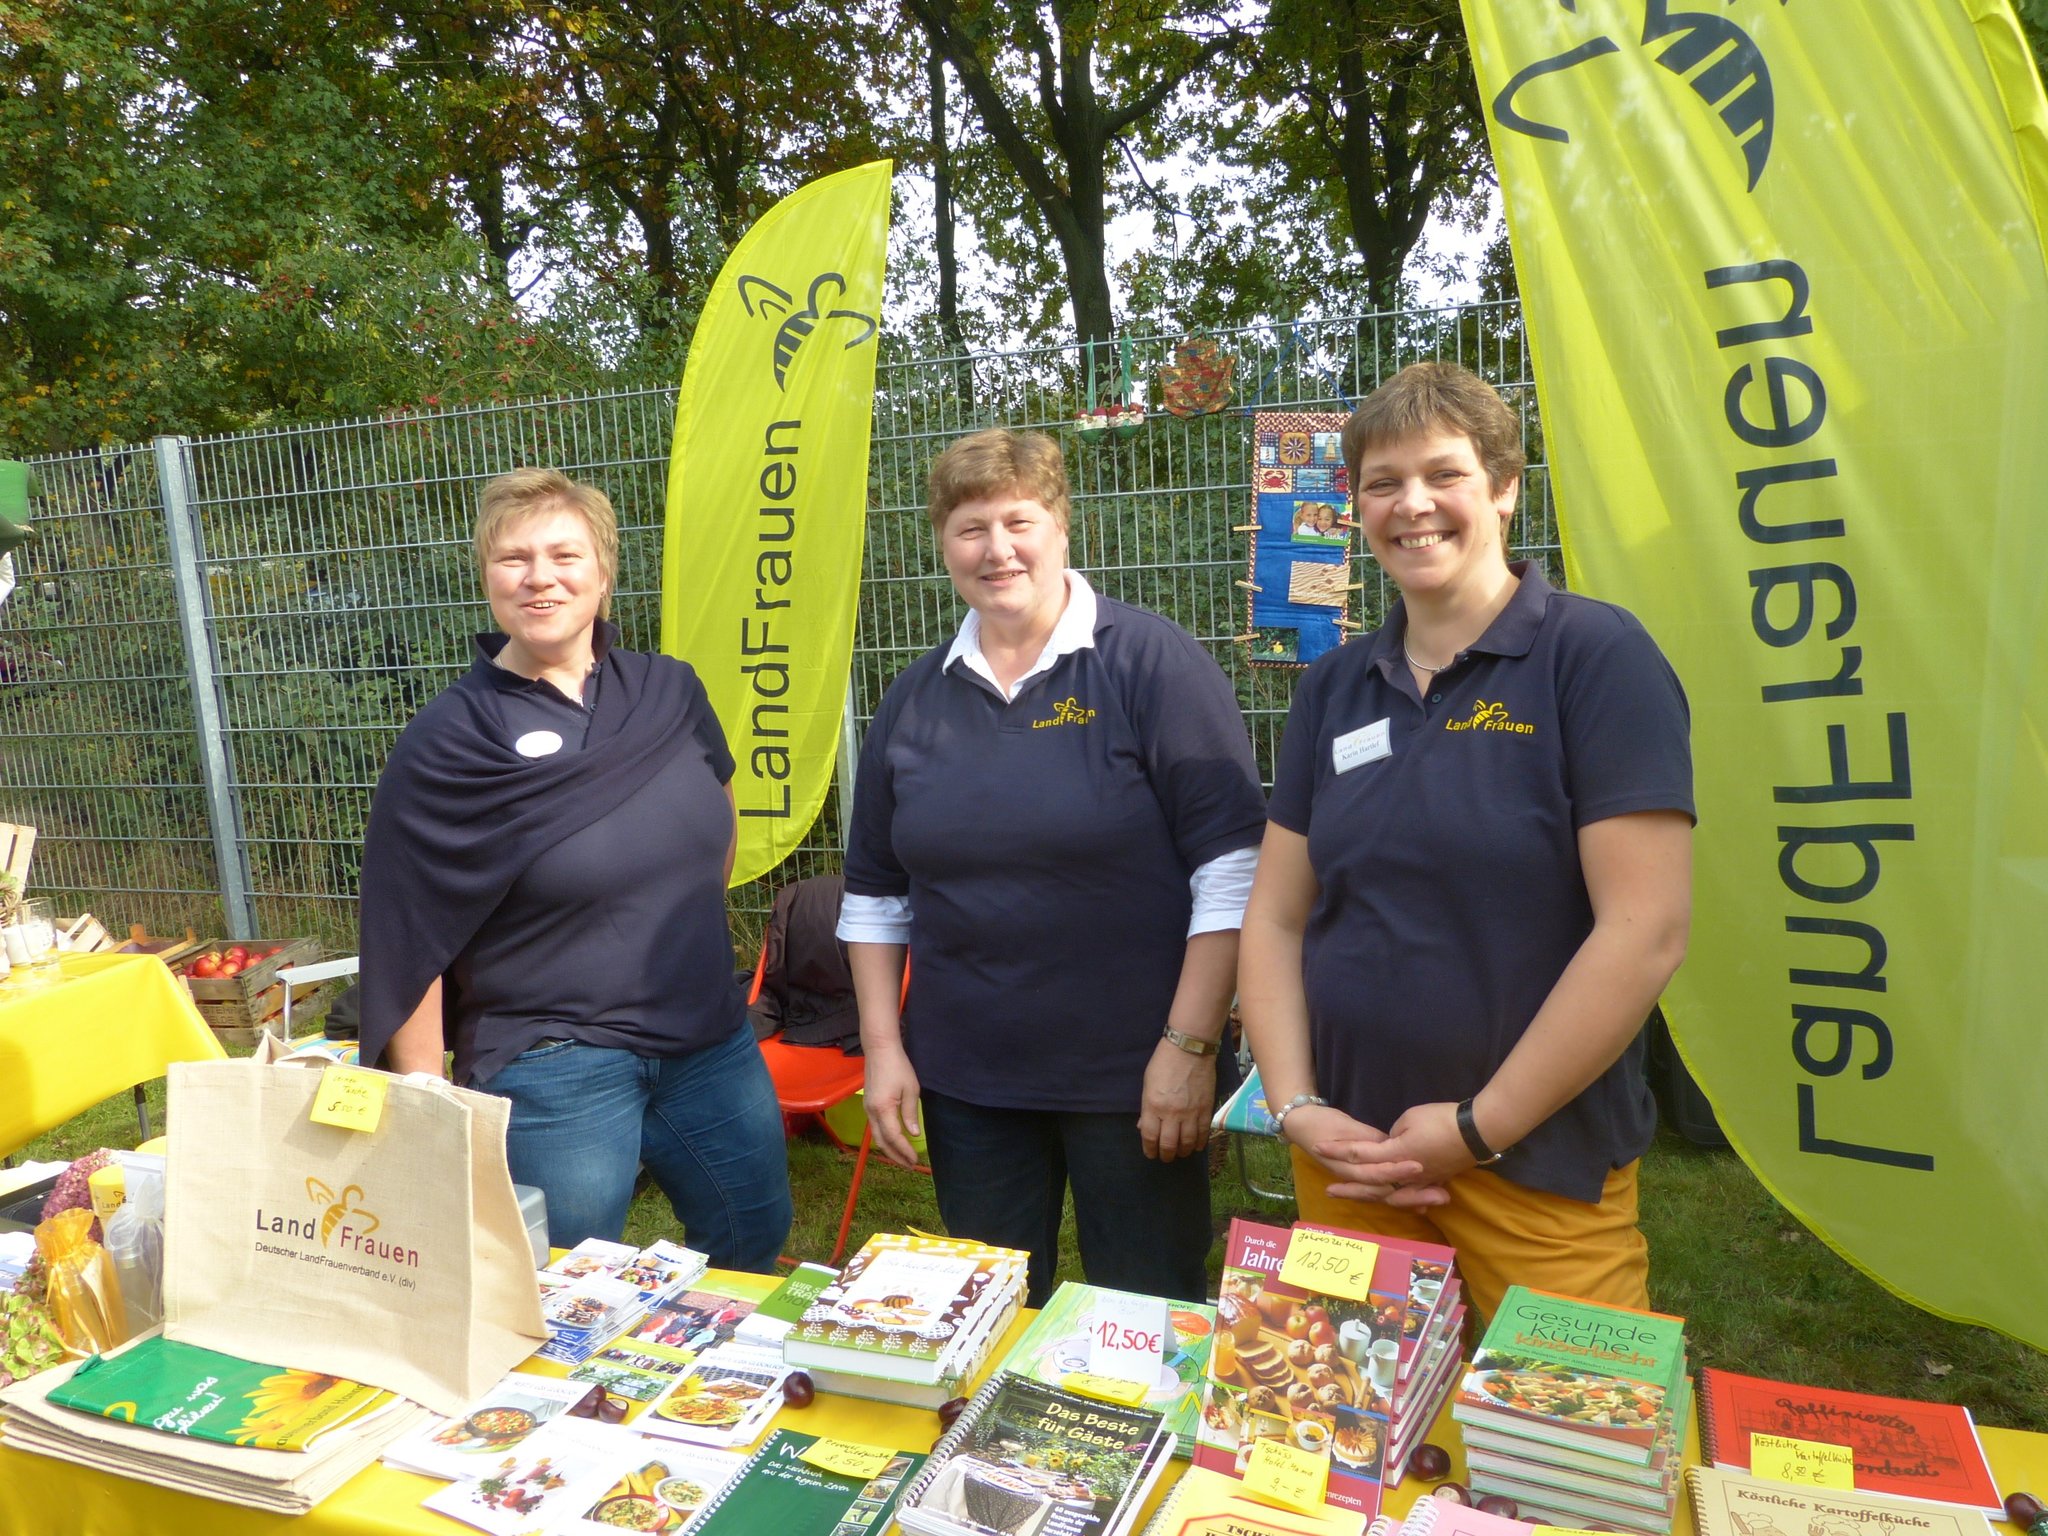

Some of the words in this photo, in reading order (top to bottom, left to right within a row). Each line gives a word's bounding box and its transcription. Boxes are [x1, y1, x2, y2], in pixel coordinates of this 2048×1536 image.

[738, 419, 803, 818] LandFrauen
[1032, 716, 1059, 729] Land
[1445, 716, 1474, 731] Land
[1483, 720, 1535, 735] Frauen
[256, 1209, 317, 1240] Land
[340, 1225, 419, 1268] Frauen
[1243, 1235, 1265, 1247] Durch
[1265, 1240, 1278, 1250] die
[255, 1241, 299, 1259] Deutscher
[299, 1250, 381, 1279] LandFrauenverband
[1296, 1251, 1350, 1274] 12,50
[1350, 1271, 1364, 1286] €
[1096, 1320, 1162, 1354] 12,50€
[1516, 1304, 1657, 1345] Gesunde
[1530, 1322, 1631, 1355] Küche
[1514, 1331, 1660, 1369] kinderleicht
[1037, 1417, 1066, 1434] für
[1067, 1427, 1126, 1450] Gäste
[1045, 1402, 1081, 1422] Das
[1083, 1412, 1140, 1436] Beste
[767, 1461, 784, 1470] Das
[778, 1469, 794, 1479] der
[1812, 1469, 1826, 1483] €
[1737, 1489, 1807, 1510] Köstliche
[1813, 1502, 1932, 1529] Kartoffelküche
